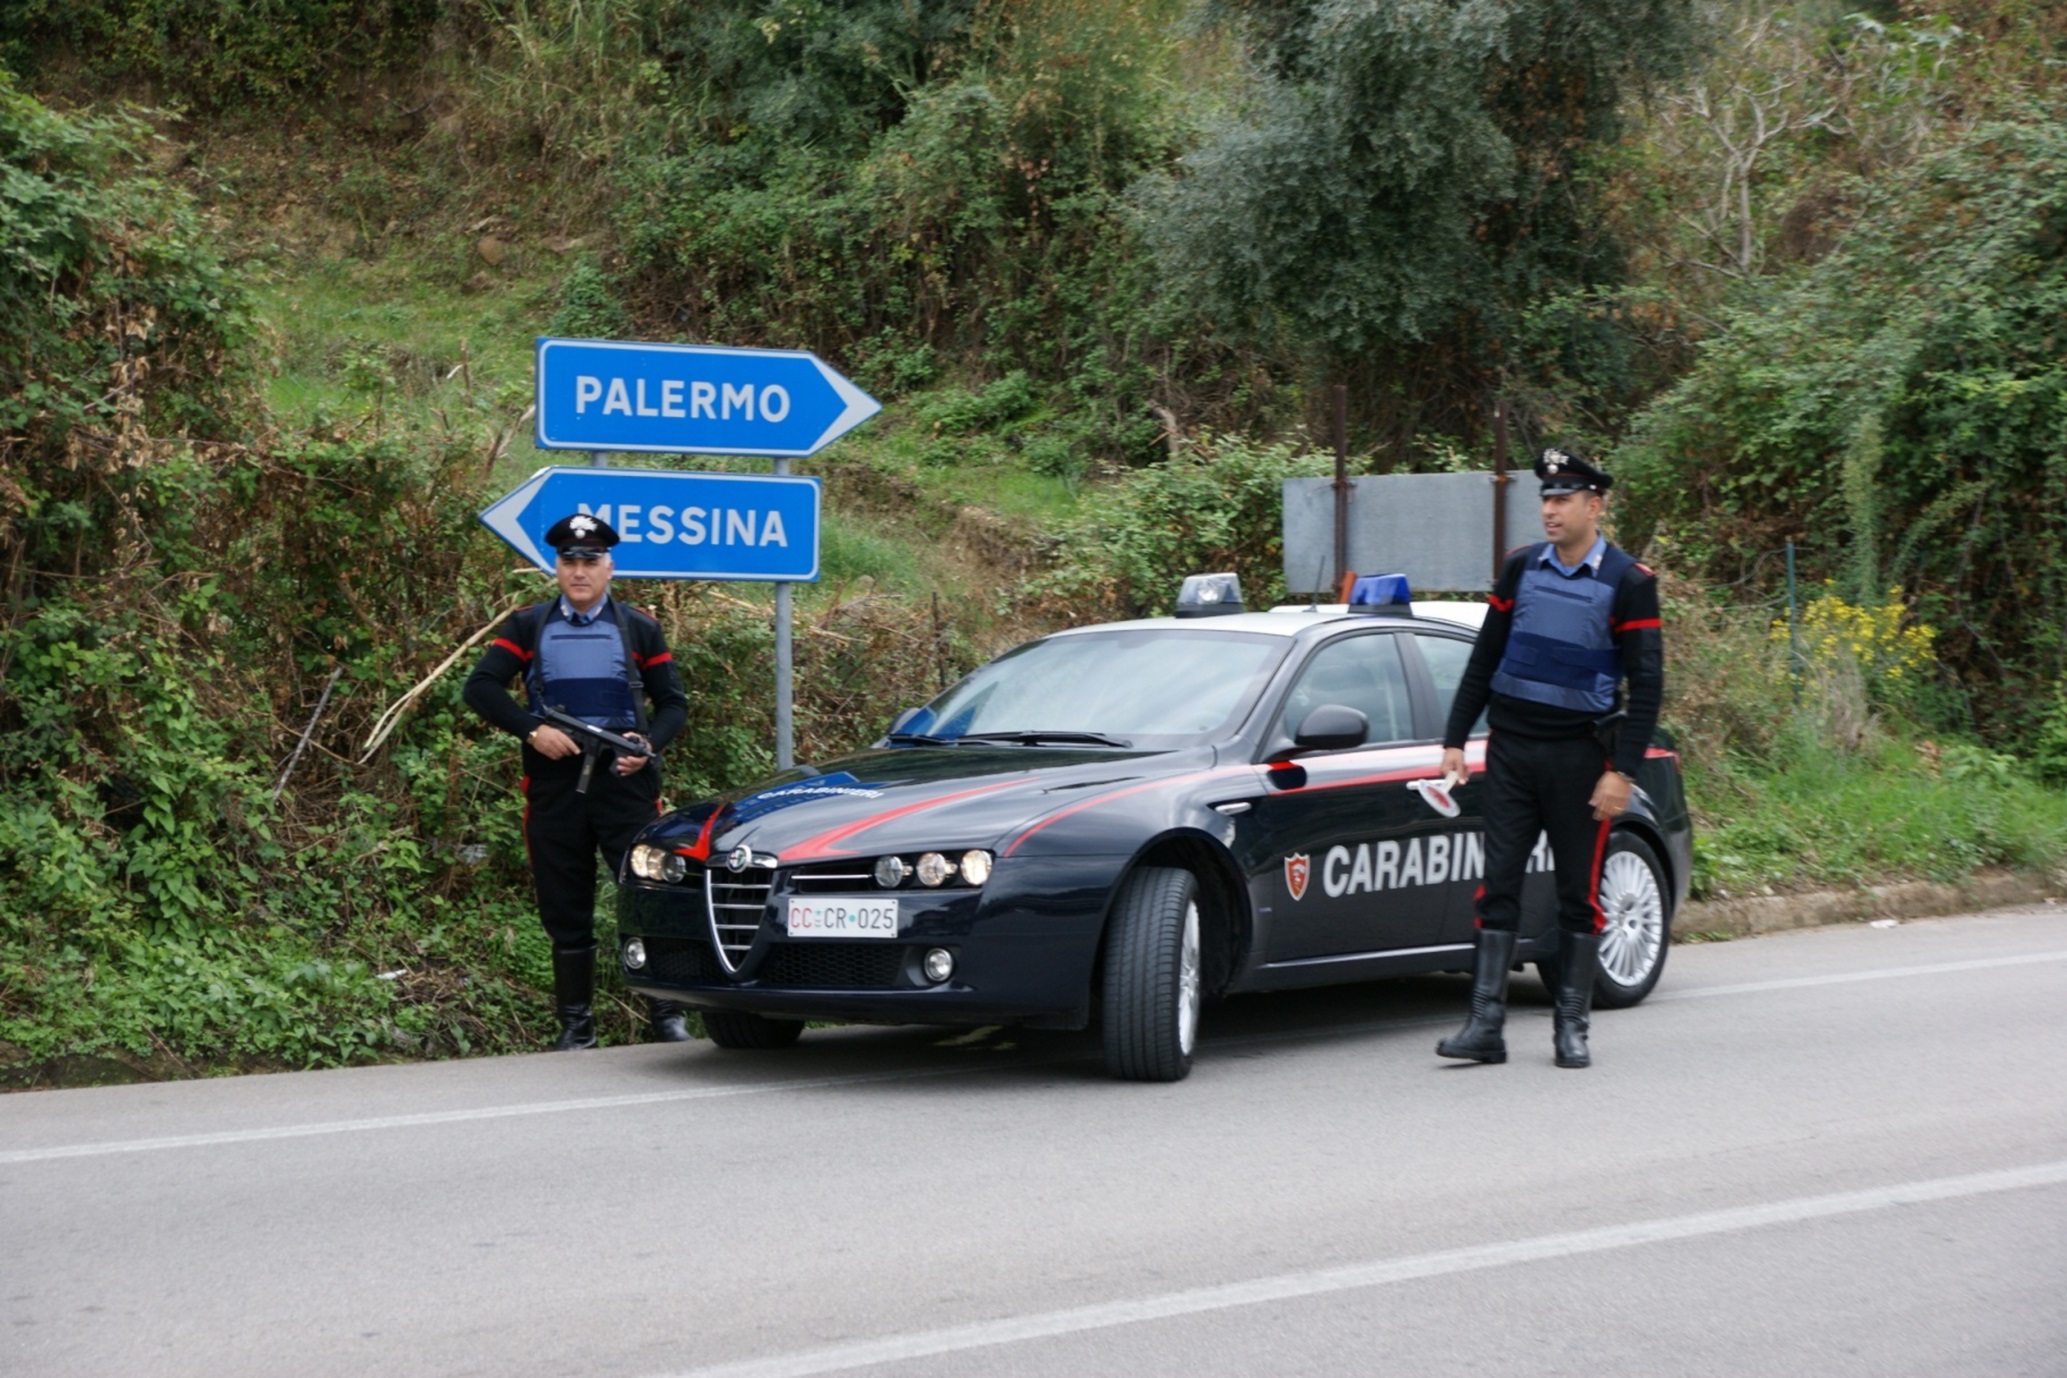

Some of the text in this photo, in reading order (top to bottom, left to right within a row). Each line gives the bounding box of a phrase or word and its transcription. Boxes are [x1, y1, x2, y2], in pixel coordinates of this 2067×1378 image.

[576, 375, 791, 423] PALERMO
[757, 787, 885, 799] CARABINIERI
[1323, 829, 1556, 897] CARABINR
[790, 907, 894, 929] CC CR 025
